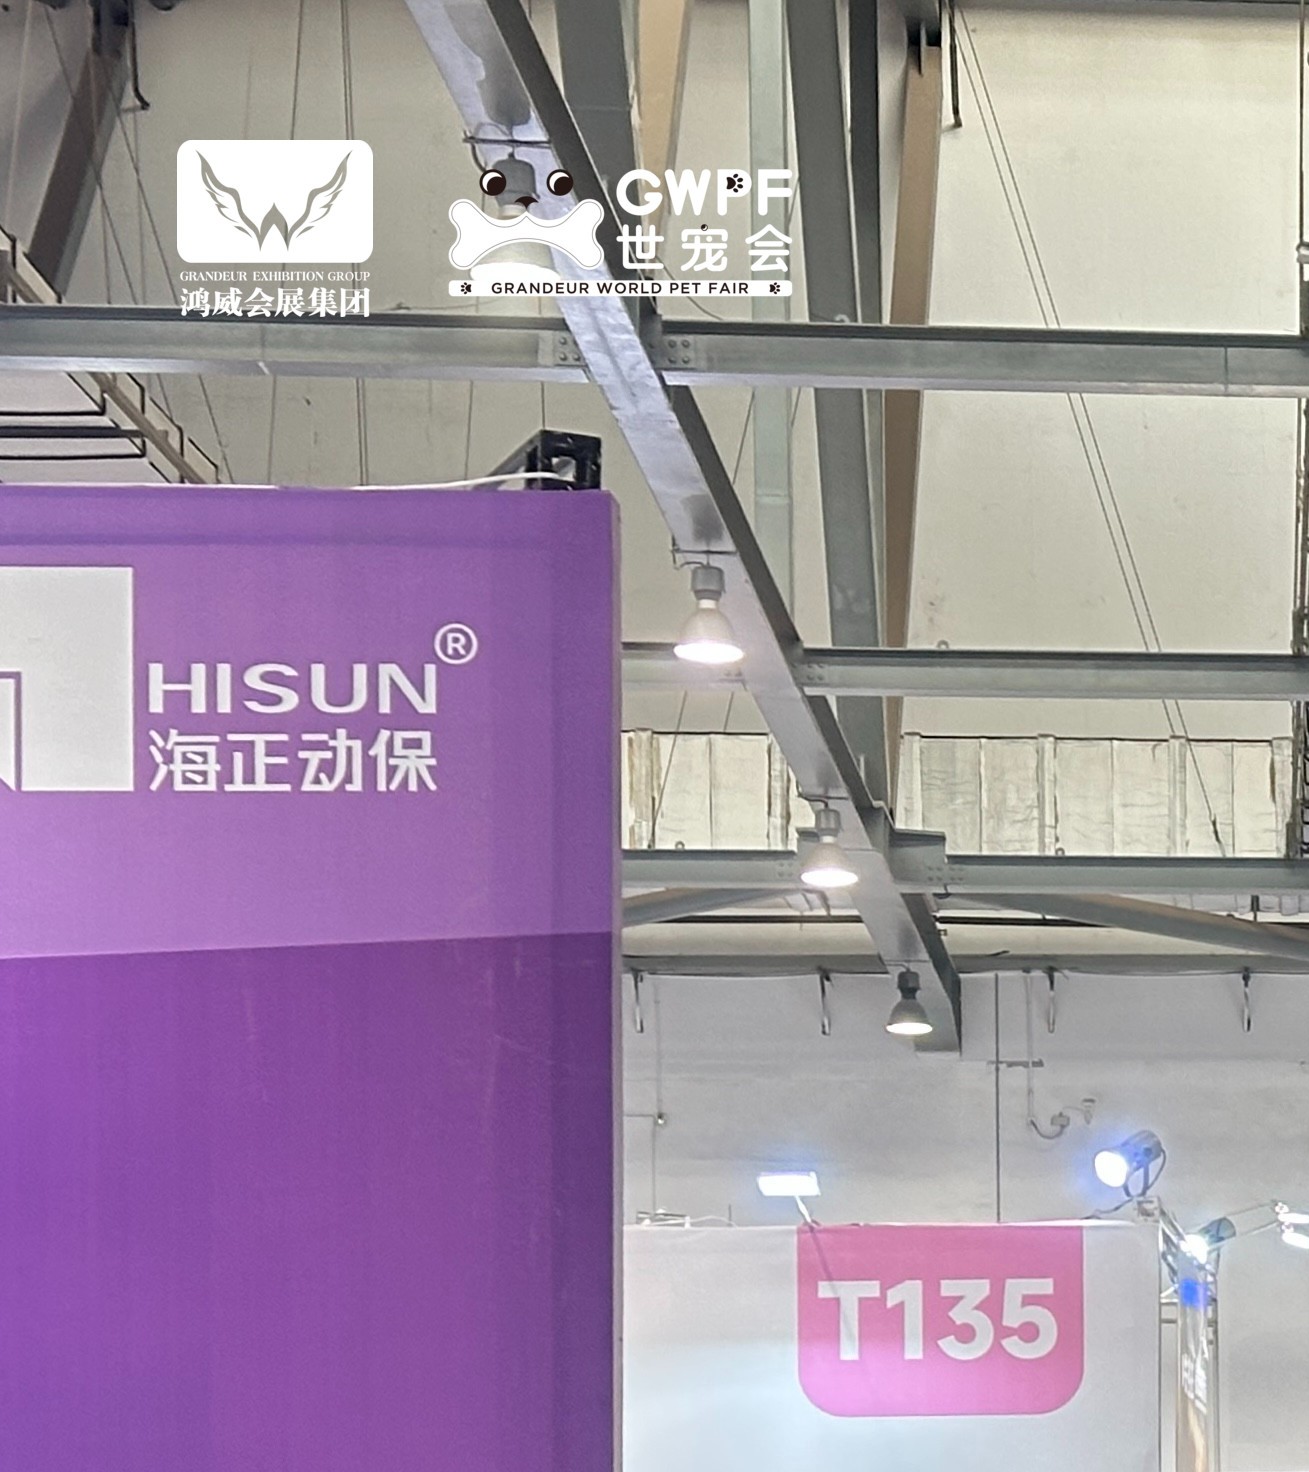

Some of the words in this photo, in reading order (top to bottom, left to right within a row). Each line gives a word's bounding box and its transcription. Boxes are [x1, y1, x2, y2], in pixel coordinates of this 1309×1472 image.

[148, 662, 437, 714] HISUN
[149, 728, 438, 792] 海正动保
[818, 1278, 1058, 1361] T135
